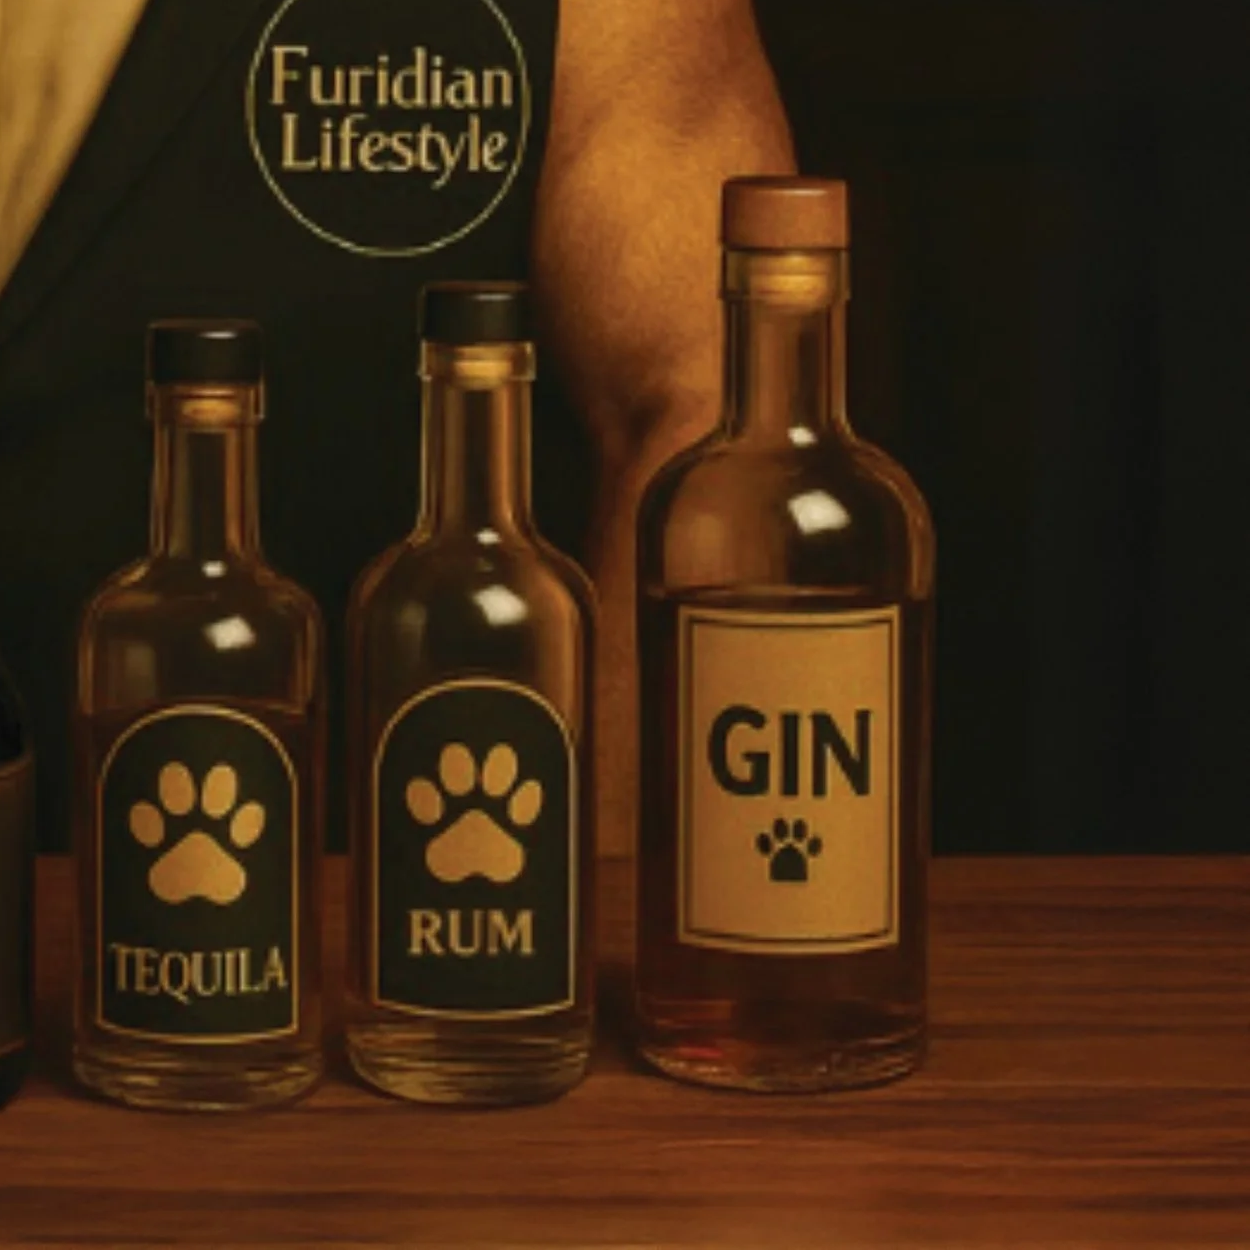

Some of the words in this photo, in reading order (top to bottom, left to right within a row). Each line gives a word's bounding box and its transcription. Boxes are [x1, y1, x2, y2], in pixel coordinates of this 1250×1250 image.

[270, 45, 514, 109] Furidian
[280, 112, 508, 190] Lifestyle
[707, 703, 872, 797] GIN
[408, 909, 534, 956] RUM
[111, 944, 287, 1003] TEQUILA
